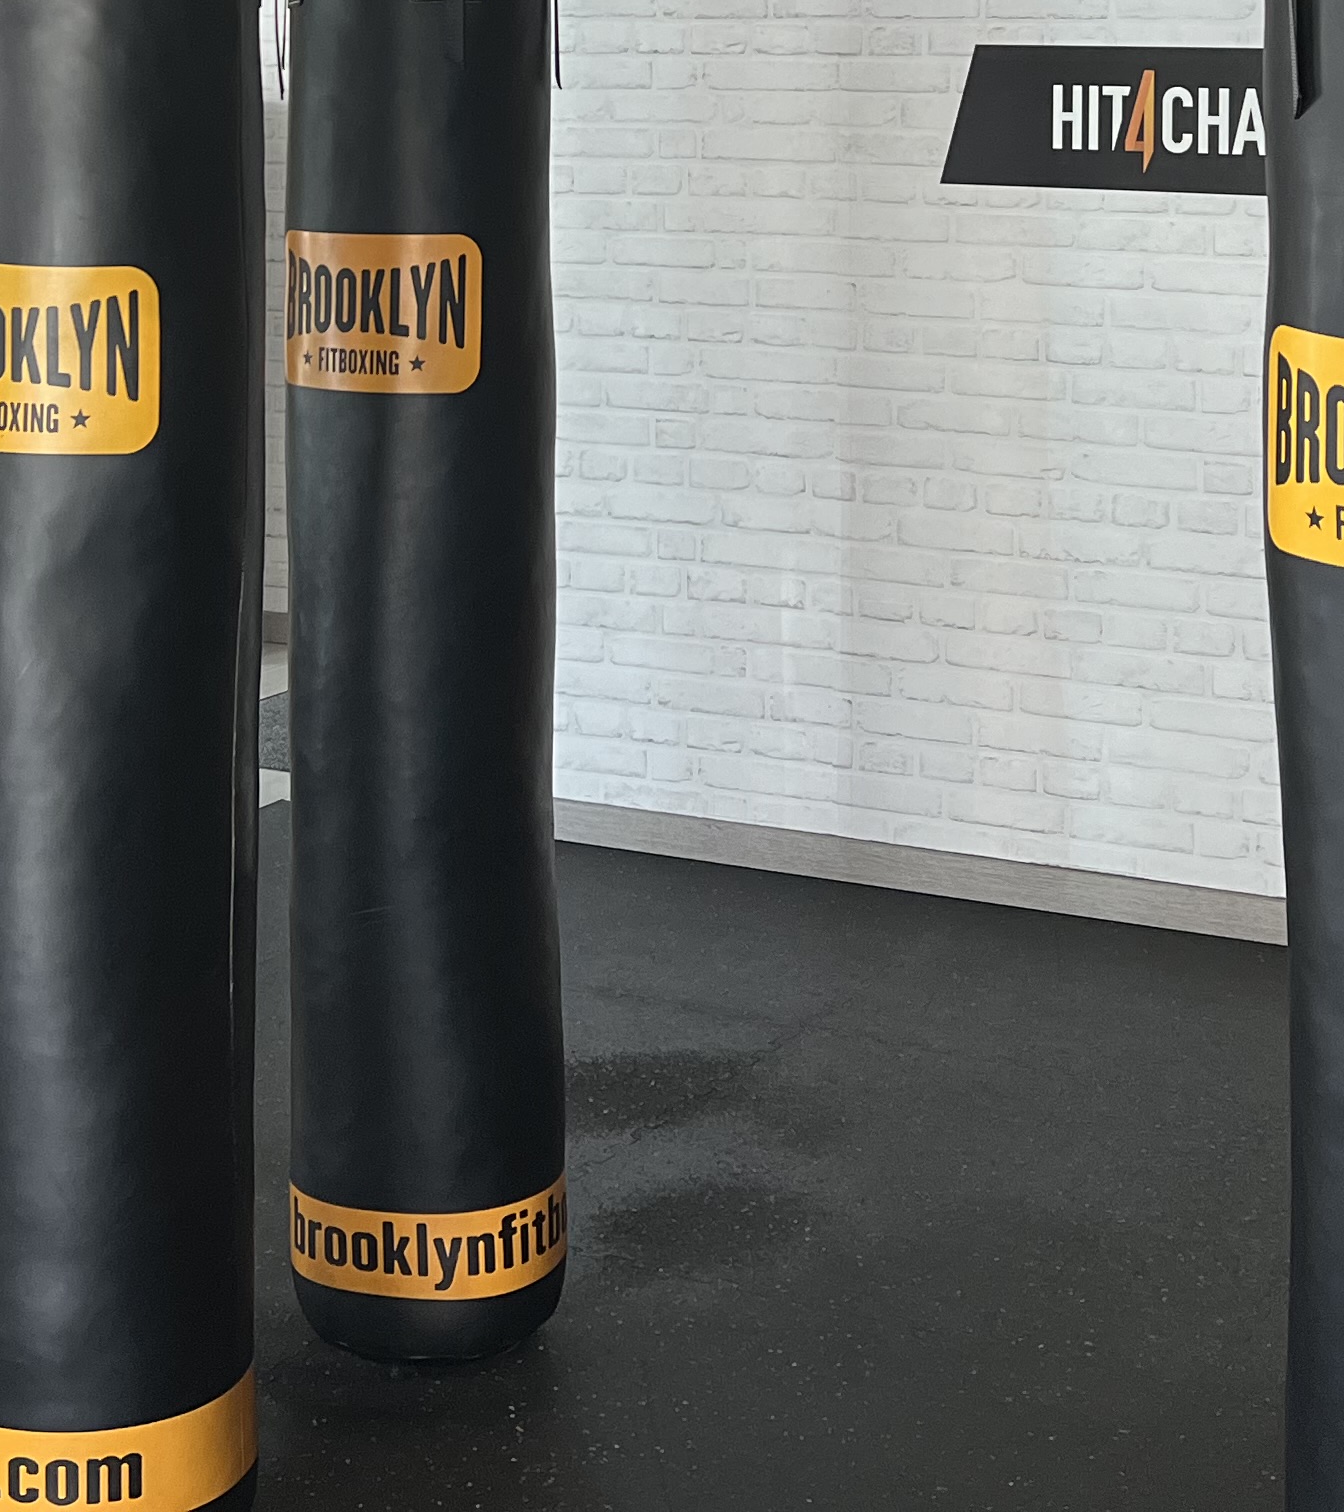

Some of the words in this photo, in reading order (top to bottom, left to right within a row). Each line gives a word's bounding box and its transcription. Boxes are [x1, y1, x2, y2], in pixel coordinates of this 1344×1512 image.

[1052, 69, 1267, 174] HIT4CHA
[287, 248, 467, 350] BROOKLYN
[318, 346, 400, 376] FITBOXING
